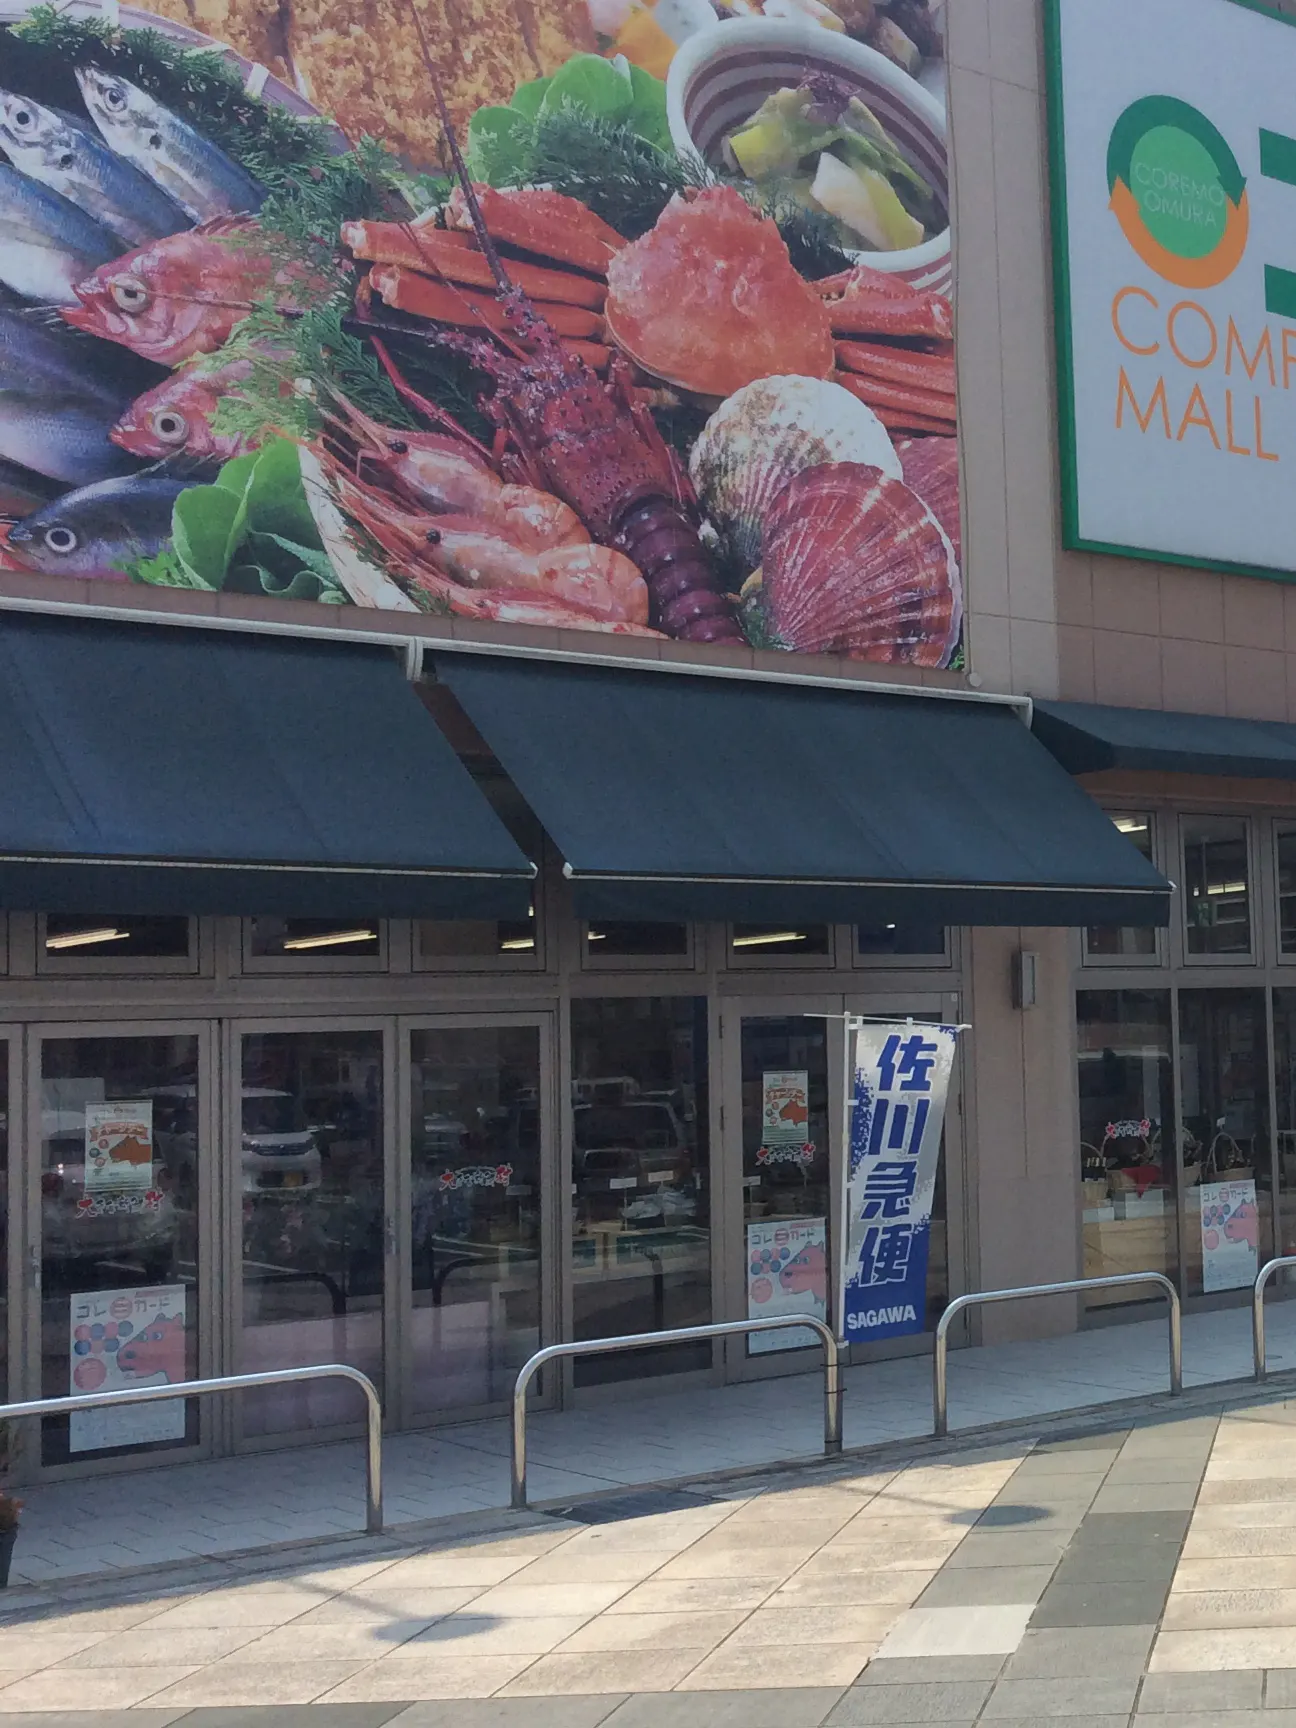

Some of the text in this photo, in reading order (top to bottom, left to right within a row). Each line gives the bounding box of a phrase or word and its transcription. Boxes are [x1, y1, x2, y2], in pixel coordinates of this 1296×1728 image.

[1135, 162, 1225, 206] COREMO
[1144, 189, 1217, 227] OMURA
[1114, 364, 1280, 463] MALL
[859, 1034, 938, 1286] 佐川急便
[847, 1304, 916, 1329] SAGAWA
